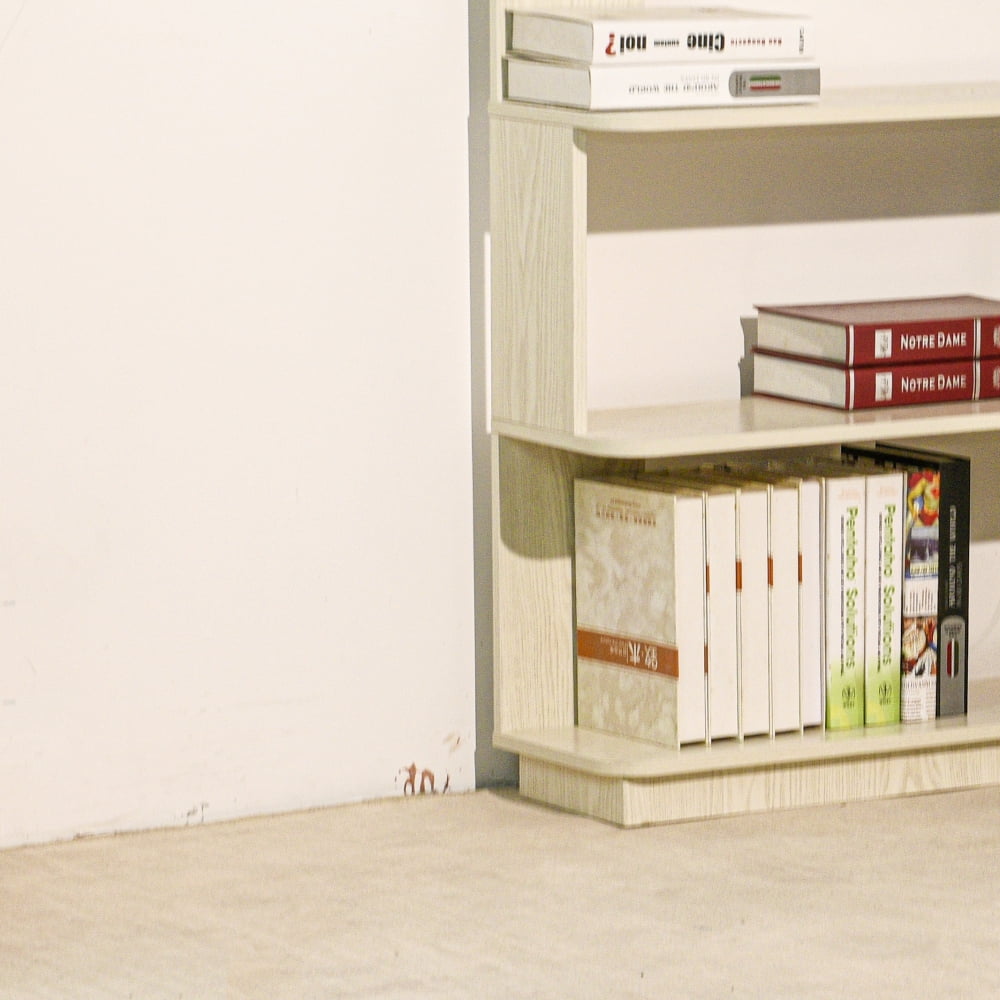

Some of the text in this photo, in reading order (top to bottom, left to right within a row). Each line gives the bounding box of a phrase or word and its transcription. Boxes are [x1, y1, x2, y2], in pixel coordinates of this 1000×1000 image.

[686, 31, 725, 51] Cine
[900, 332, 936, 351] NOTRE
[936, 331, 967, 347] DAME
[901, 375, 936, 393] NOTRE
[936, 374, 967, 390] DAME
[845, 506, 859, 580] Pentaho
[883, 503, 896, 577] Pentaho
[845, 587, 859, 669] Solutions
[882, 584, 896, 665] Solutions
